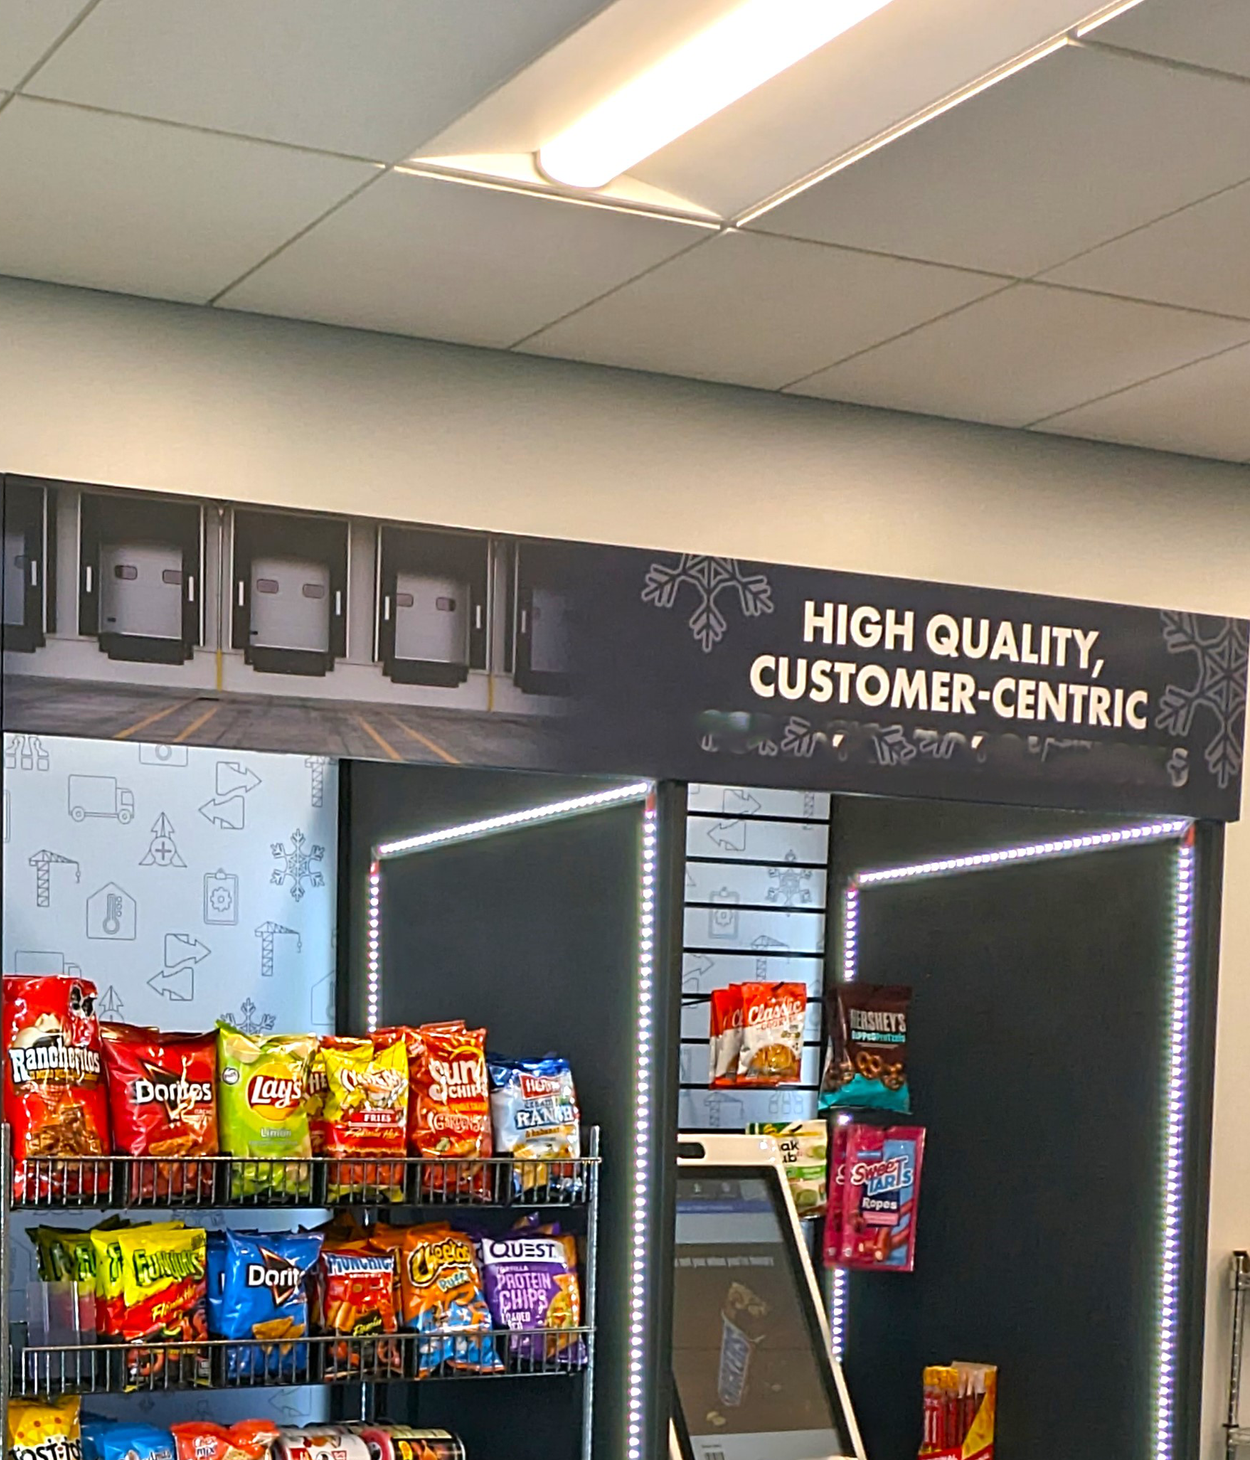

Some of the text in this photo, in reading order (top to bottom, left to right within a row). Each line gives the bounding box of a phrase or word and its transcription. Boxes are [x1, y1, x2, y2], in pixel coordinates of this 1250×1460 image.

[802, 600, 1106, 679] HIGH QUALITY,
[750, 655, 1148, 731] CUSTOMER-CENTRIC
[747, 997, 803, 1026] Classic
[850, 1009, 907, 1033] HERSHEY'S
[8, 1035, 101, 1084] Rancheritos
[135, 1079, 212, 1105] Doritos
[363, 1113, 392, 1123] FRIES
[516, 1104, 574, 1128] RANCH
[862, 1196, 898, 1211] Ropes
[489, 1240, 556, 1258] QUEST
[133, 1249, 205, 1286] FUNYUNS
[408, 1238, 472, 1287] Cheetos
[496, 1272, 551, 1290] PROTEIN
[499, 1289, 548, 1311] CHIPS
